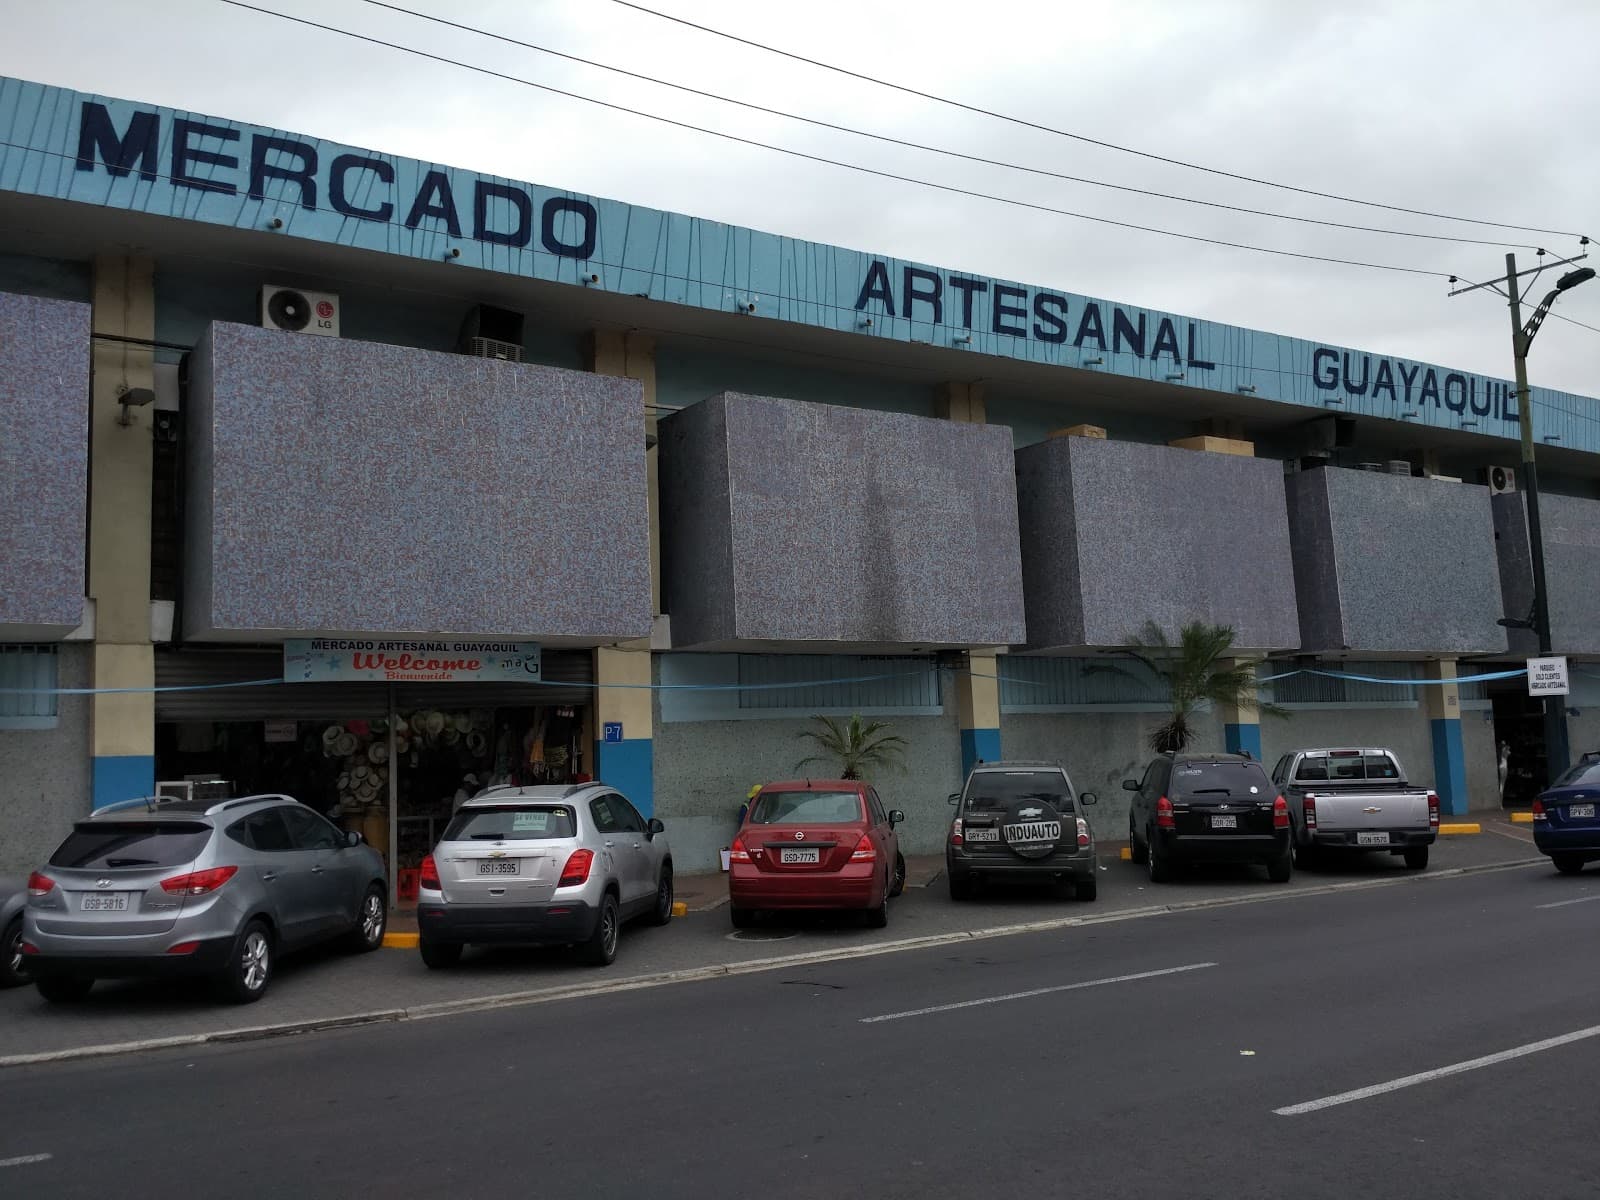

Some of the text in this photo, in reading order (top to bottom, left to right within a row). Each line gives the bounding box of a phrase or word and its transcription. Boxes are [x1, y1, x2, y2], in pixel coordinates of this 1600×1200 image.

[75, 101, 1520, 421] MERCADO ARTESANAL GUAYAQUIL
[318, 320, 332, 329] LG
[311, 640, 519, 652] MERCADO ARTESANAL GUAYAQUIL
[352, 651, 482, 671] Welcome
[1005, 821, 1059, 841] INDUAUTO
[480, 863, 516, 873] GSI-3595
